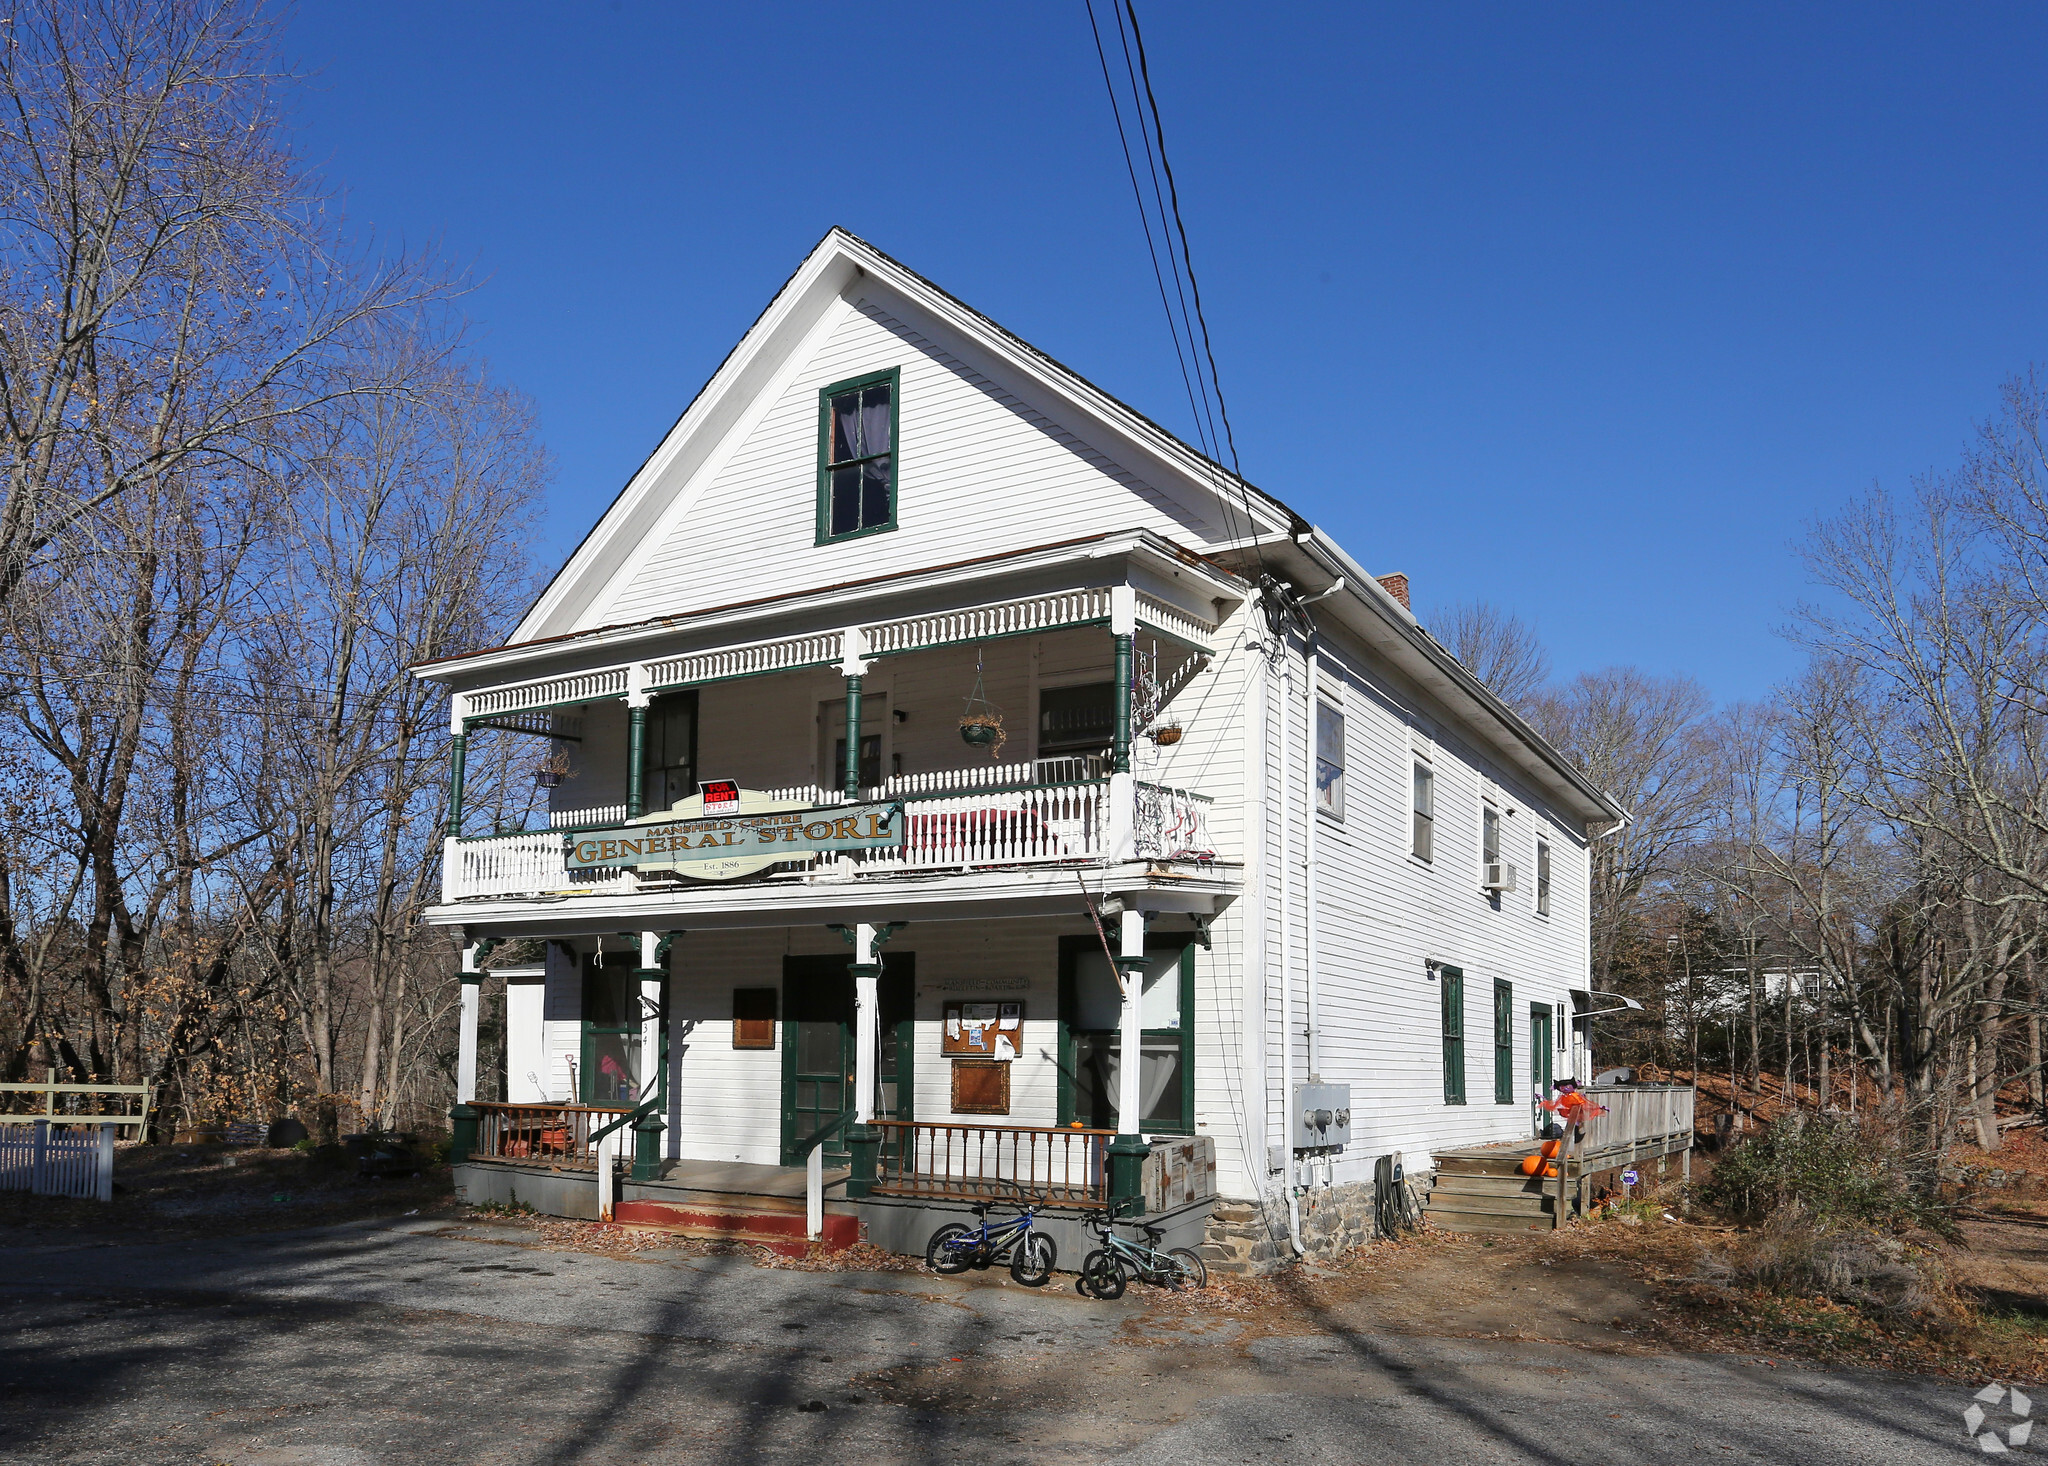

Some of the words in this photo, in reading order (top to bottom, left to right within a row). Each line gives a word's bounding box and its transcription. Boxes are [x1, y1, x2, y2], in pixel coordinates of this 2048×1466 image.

[708, 782, 730, 793] FOR
[705, 790, 737, 803] RENT
[739, 814, 803, 827] CENTRE
[574, 831, 746, 864] GENERAL
[757, 812, 893, 844] STORE
[704, 862, 718, 871] Est.
[721, 860, 740, 870] 1886
